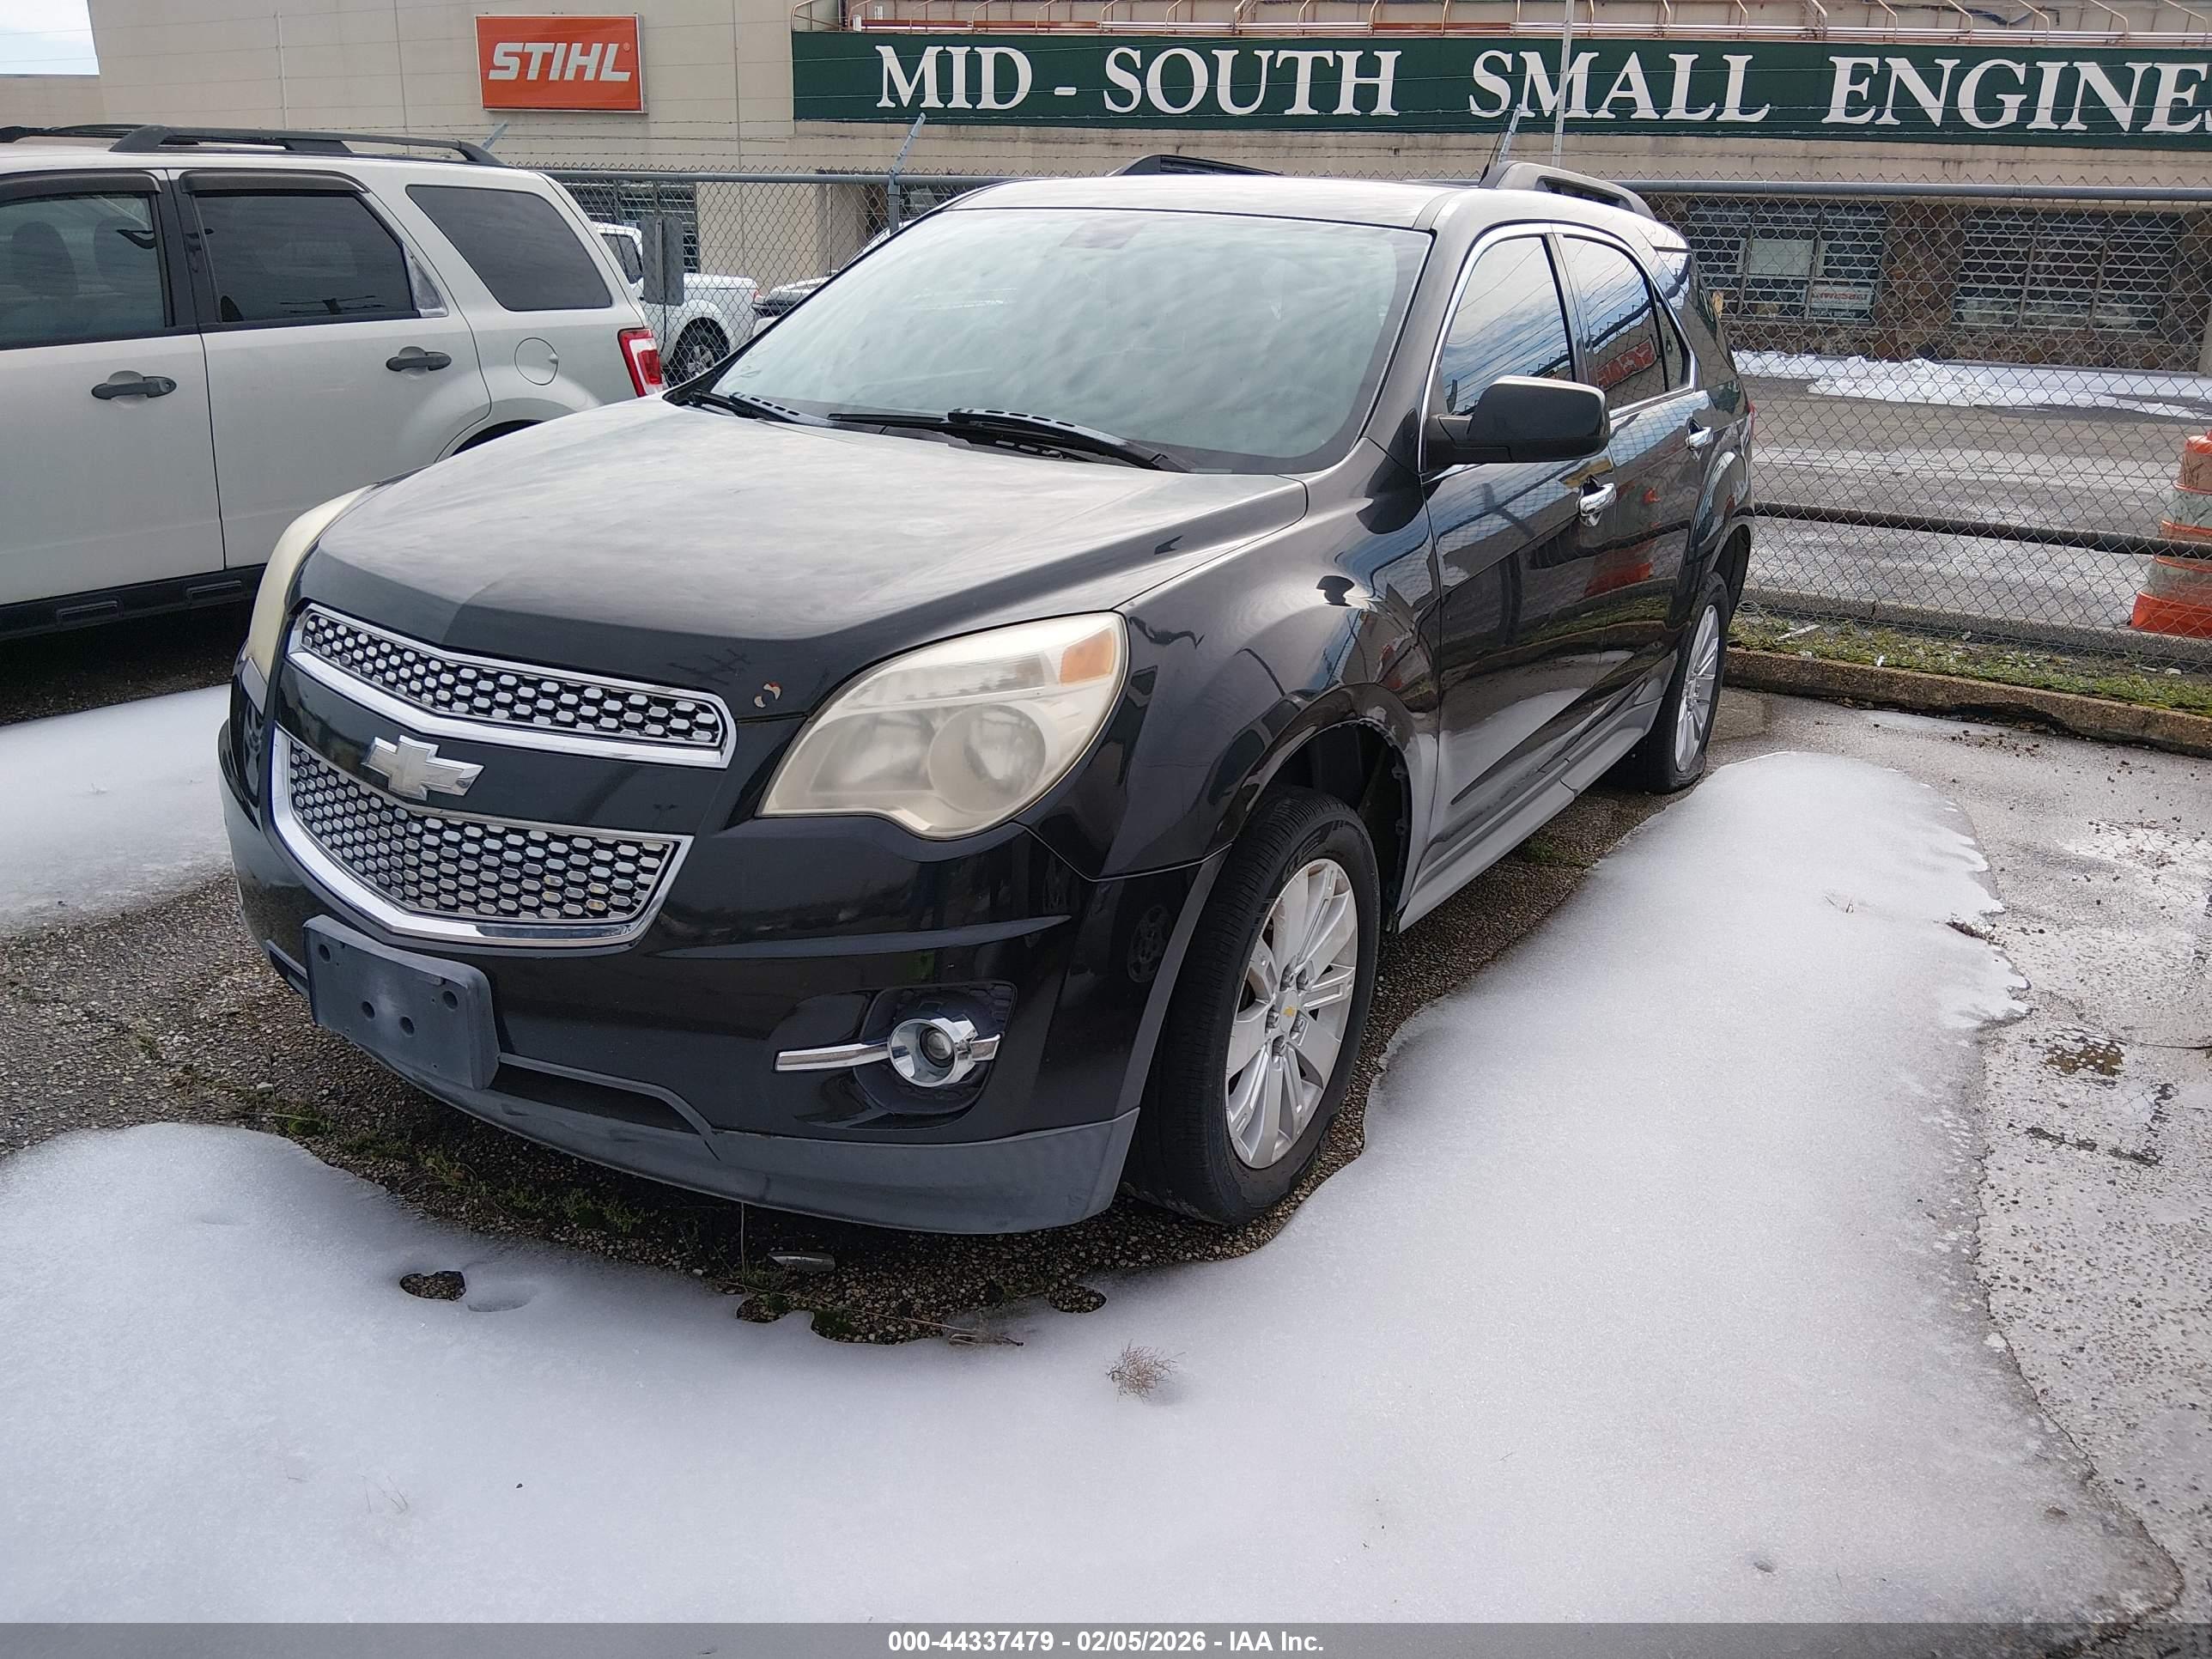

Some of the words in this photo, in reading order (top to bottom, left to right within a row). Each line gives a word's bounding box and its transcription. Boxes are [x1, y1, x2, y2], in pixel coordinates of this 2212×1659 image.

[488, 42, 631, 82] STIHL
[875, 46, 1032, 110] MID
[1103, 46, 1402, 116] SOUTH
[1468, 50, 1771, 123] SMALL
[1821, 56, 2212, 133] ENGINE
